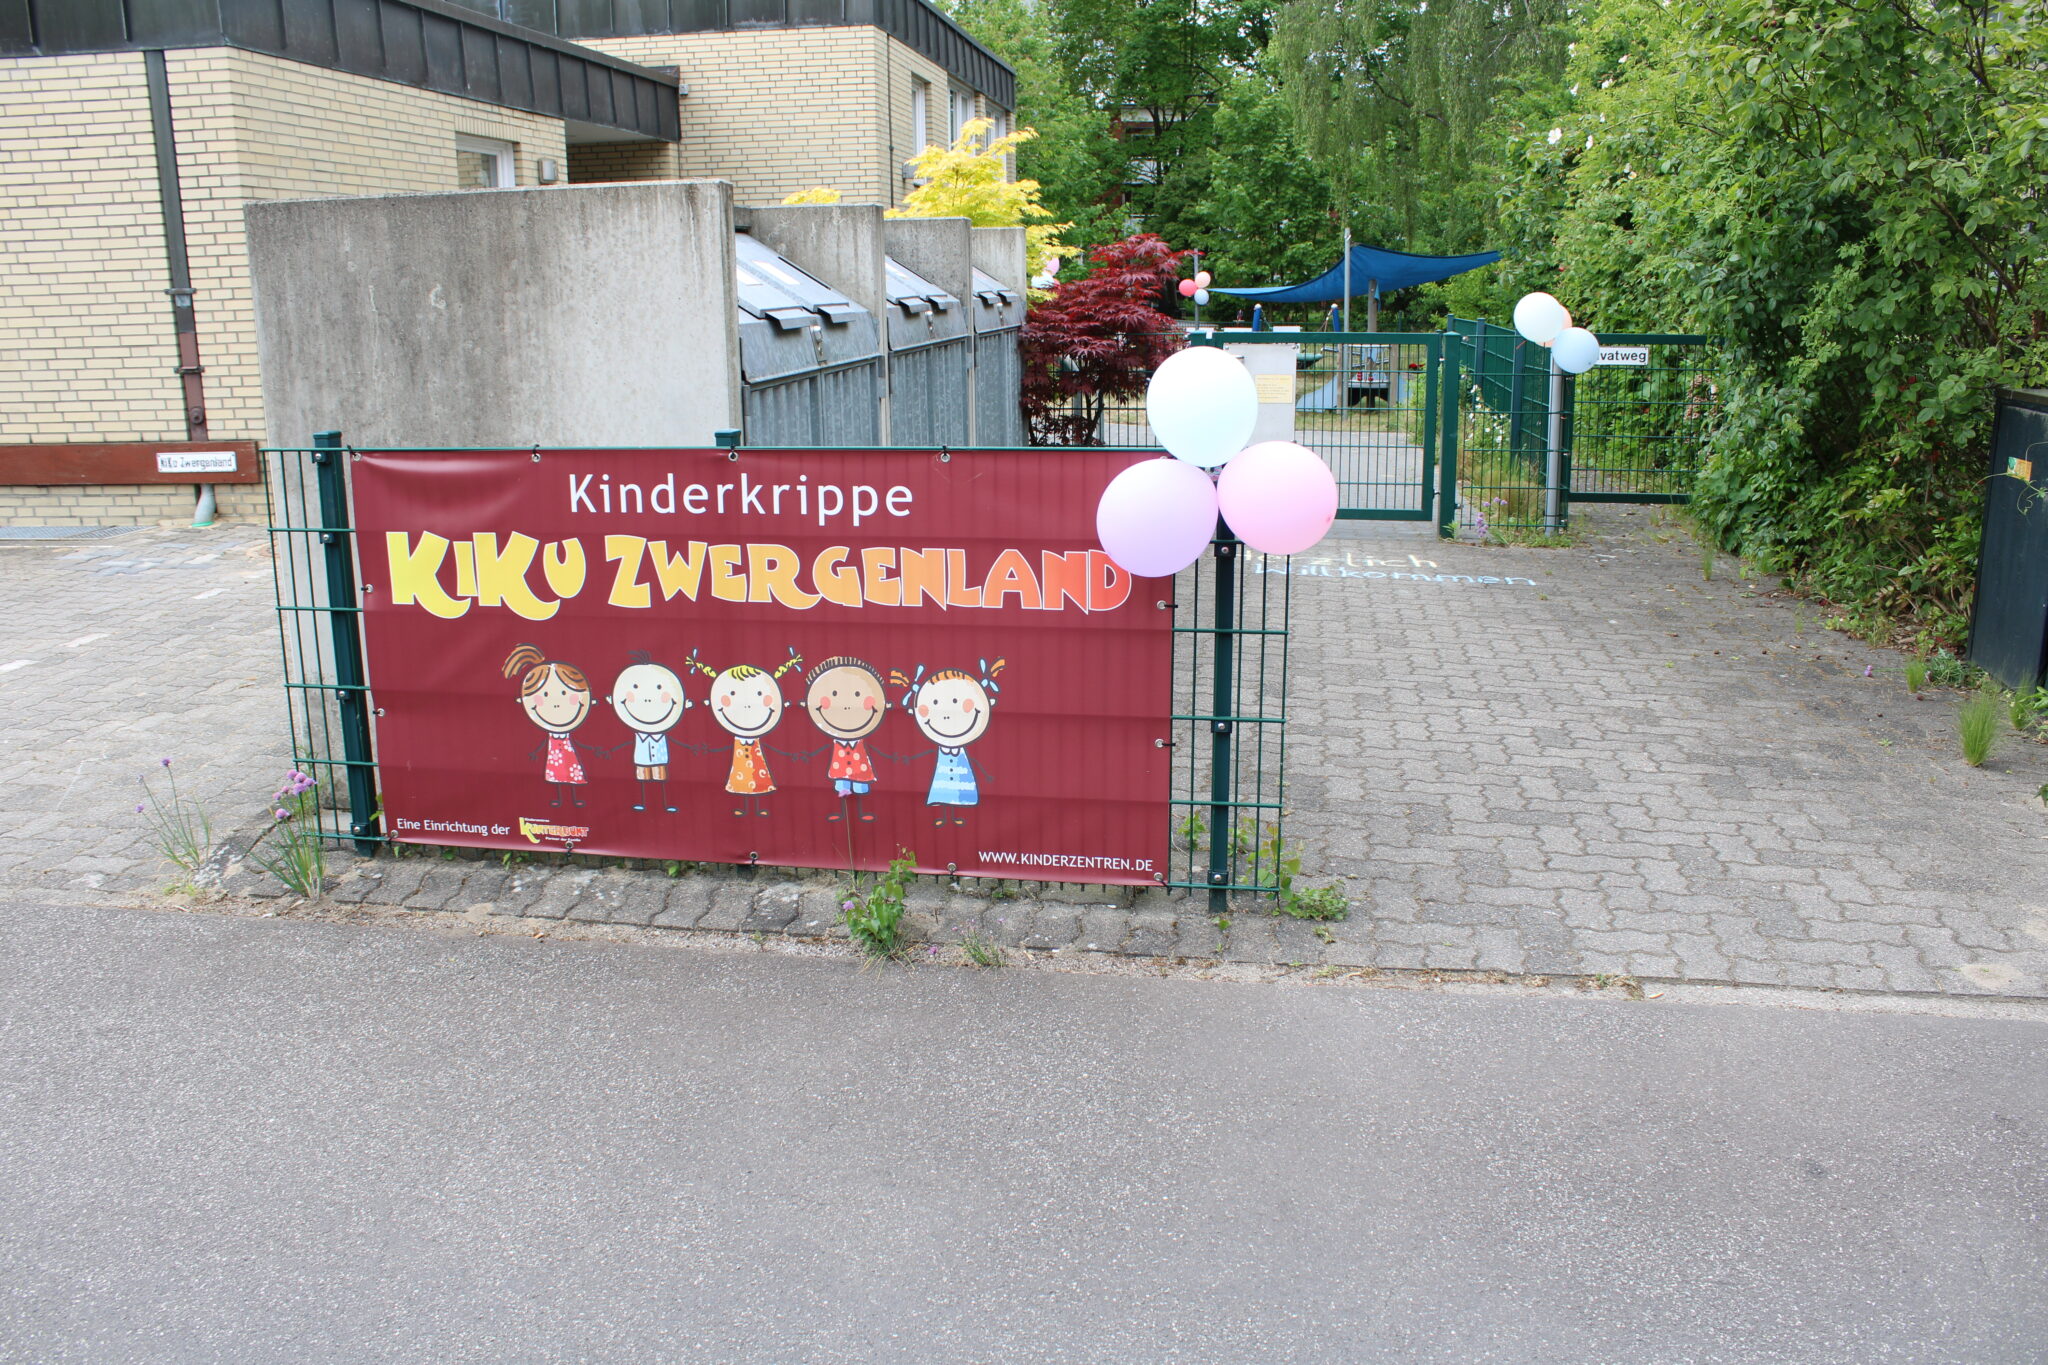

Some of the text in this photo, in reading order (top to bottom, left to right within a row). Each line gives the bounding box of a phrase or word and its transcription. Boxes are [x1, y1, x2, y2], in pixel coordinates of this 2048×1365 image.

[1600, 350, 1646, 363] vatweg
[569, 472, 914, 527] Kinderkrippe
[604, 534, 1132, 615] ZWERGENLAND
[1254, 562, 1538, 587] Willkommen
[396, 818, 510, 837] Eine Einrichtung der
[978, 851, 1153, 872] WWW.KINDERZENTREN.DE
